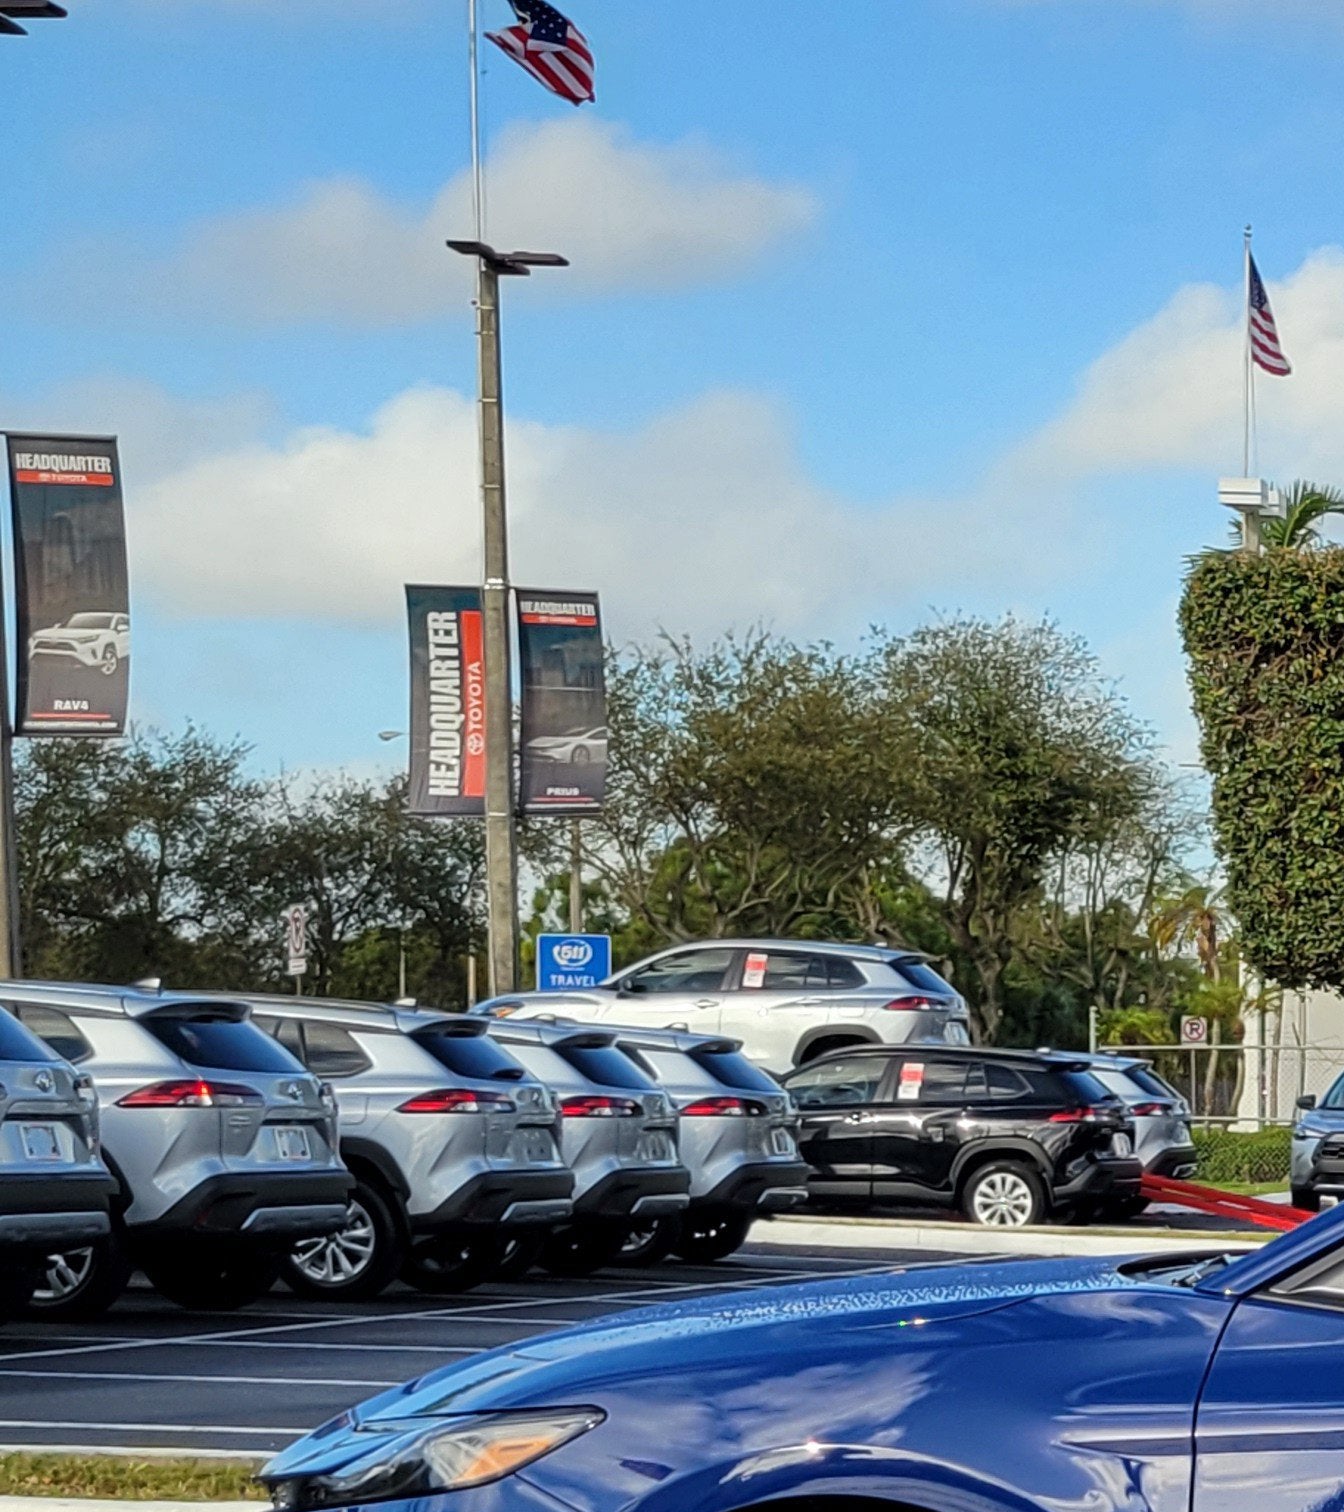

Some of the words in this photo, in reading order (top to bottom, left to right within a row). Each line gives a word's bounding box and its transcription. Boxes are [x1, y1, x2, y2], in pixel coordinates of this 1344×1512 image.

[15, 453, 112, 473] HEADQUARTER
[53, 699, 90, 711] RAV4
[427, 611, 465, 796] HEADQUARTER
[467, 661, 483, 732] TOYOTA
[550, 974, 596, 987] TRAVEL
